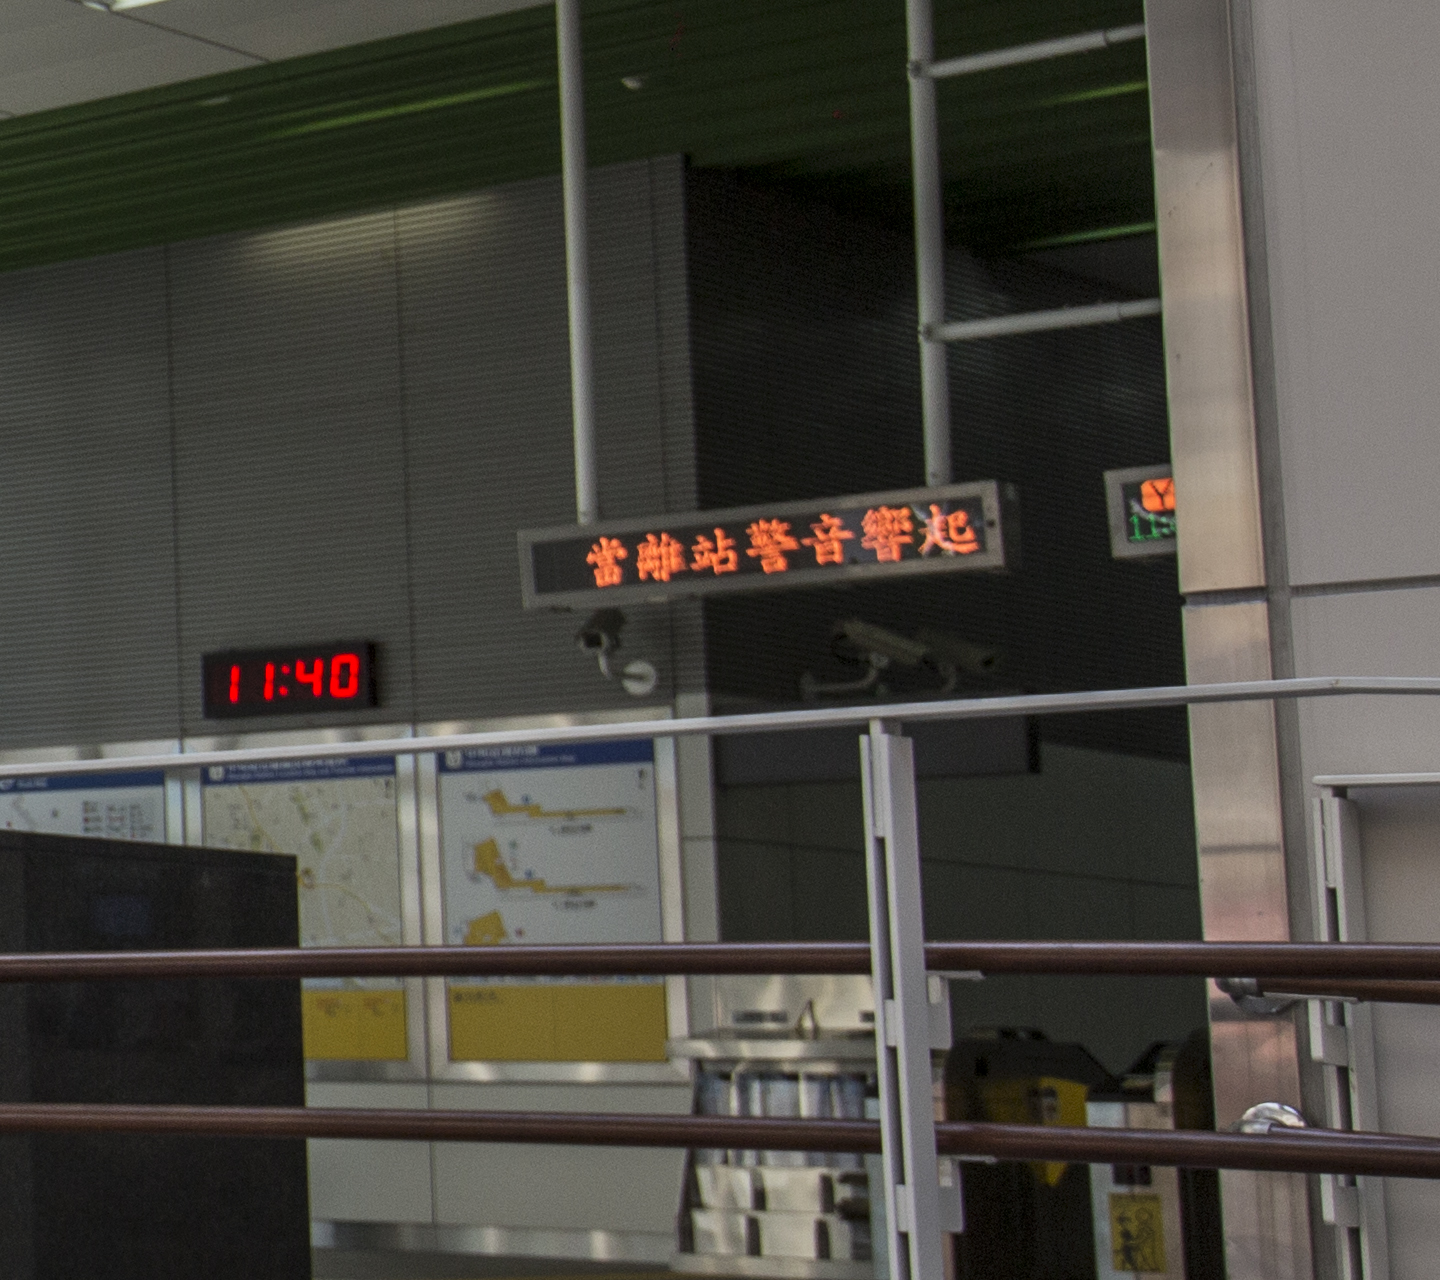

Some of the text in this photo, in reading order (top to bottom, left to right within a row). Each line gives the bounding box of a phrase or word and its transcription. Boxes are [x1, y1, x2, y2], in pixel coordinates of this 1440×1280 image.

[585, 503, 980, 588] 當離站警音響起
[226, 653, 361, 704] 11:40
